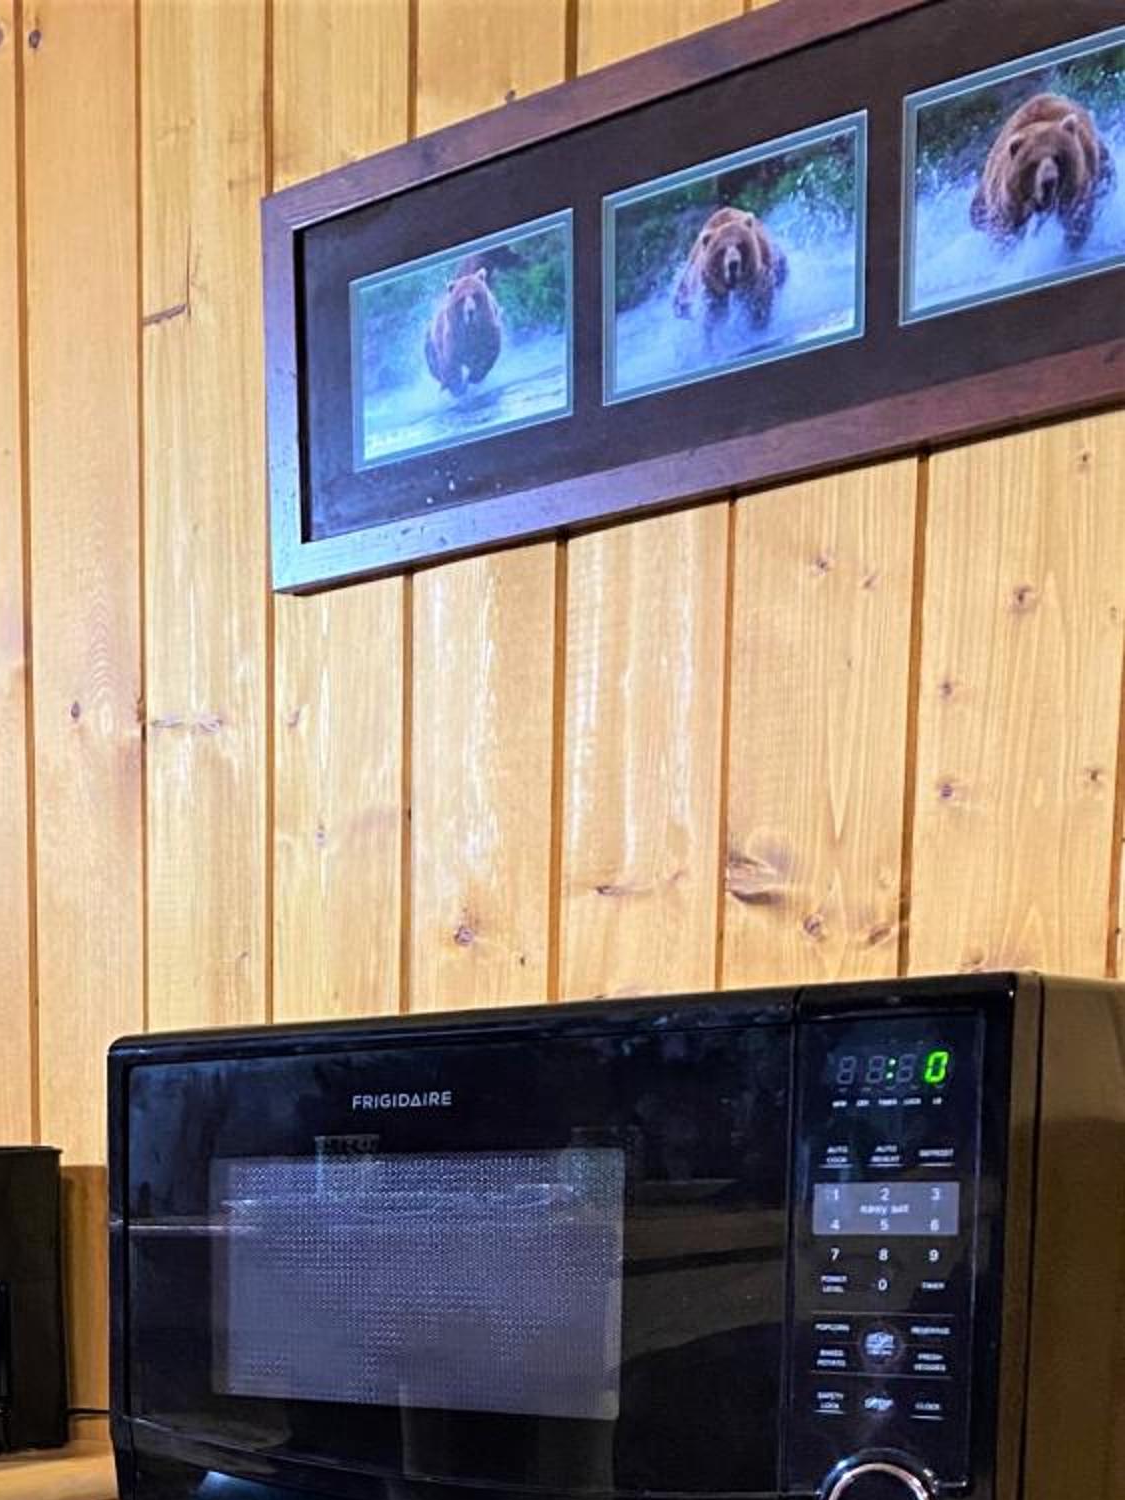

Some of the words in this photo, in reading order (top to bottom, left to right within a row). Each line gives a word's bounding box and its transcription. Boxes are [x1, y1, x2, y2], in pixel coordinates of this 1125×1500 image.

[352, 1091, 452, 1109] FRIGIDAIRE
[832, 1188, 841, 1201] 1
[879, 1187, 891, 1201] 2
[930, 1187, 941, 1201] 3
[829, 1219, 841, 1231] 4
[879, 1219, 890, 1232] 5
[930, 1219, 940, 1232] 6
[830, 1248, 841, 1261] 7
[878, 1248, 889, 1262] 8
[928, 1249, 940, 1262] 9
[878, 1278, 888, 1291] 0
